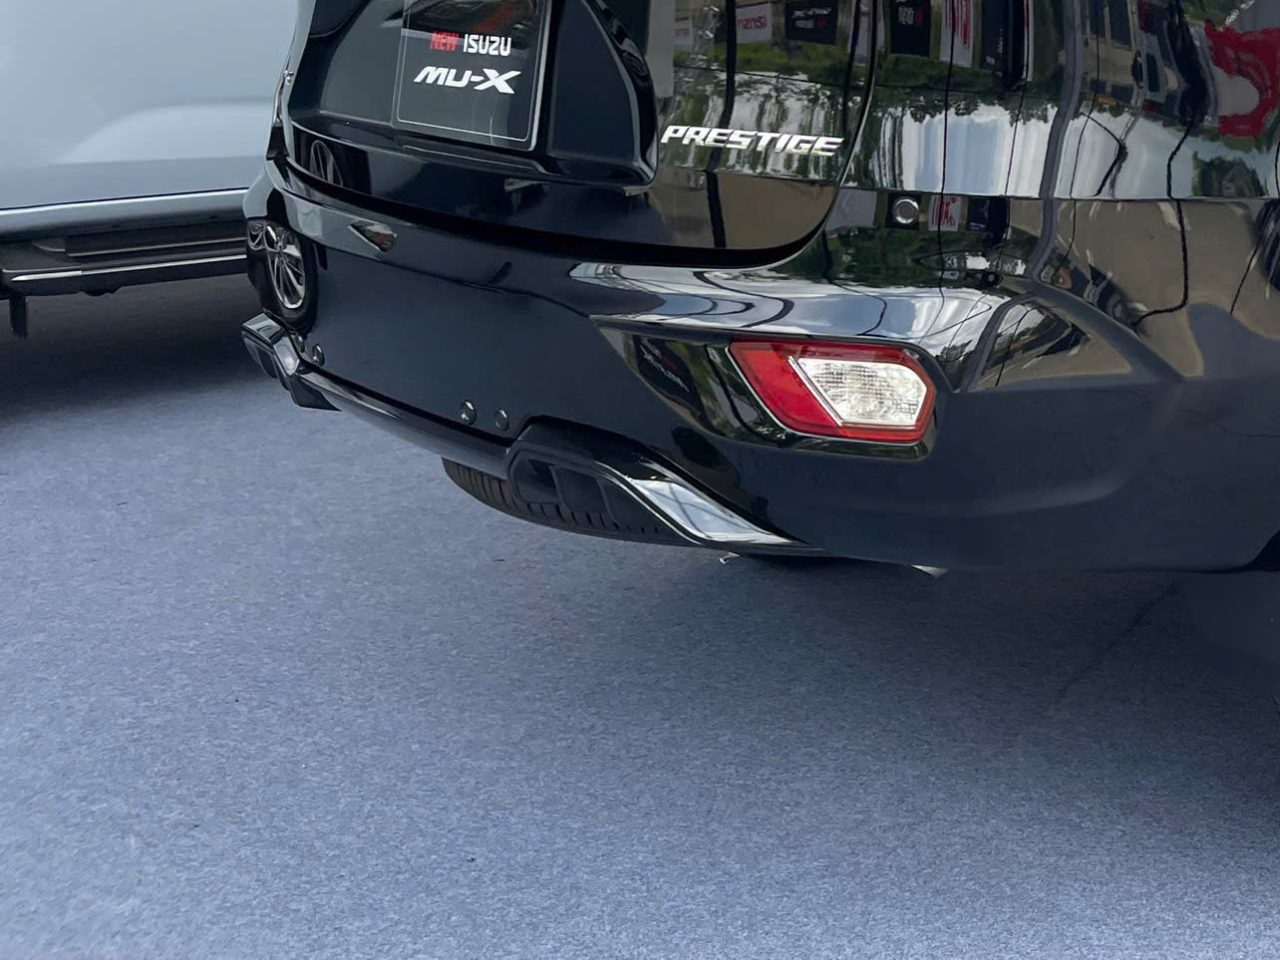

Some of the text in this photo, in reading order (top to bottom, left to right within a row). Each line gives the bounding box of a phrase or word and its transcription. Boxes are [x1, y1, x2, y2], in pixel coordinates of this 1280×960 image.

[430, 31, 512, 56] NEW ISUZU
[413, 65, 522, 95] MU-X
[661, 124, 845, 157] PRESTIGE
